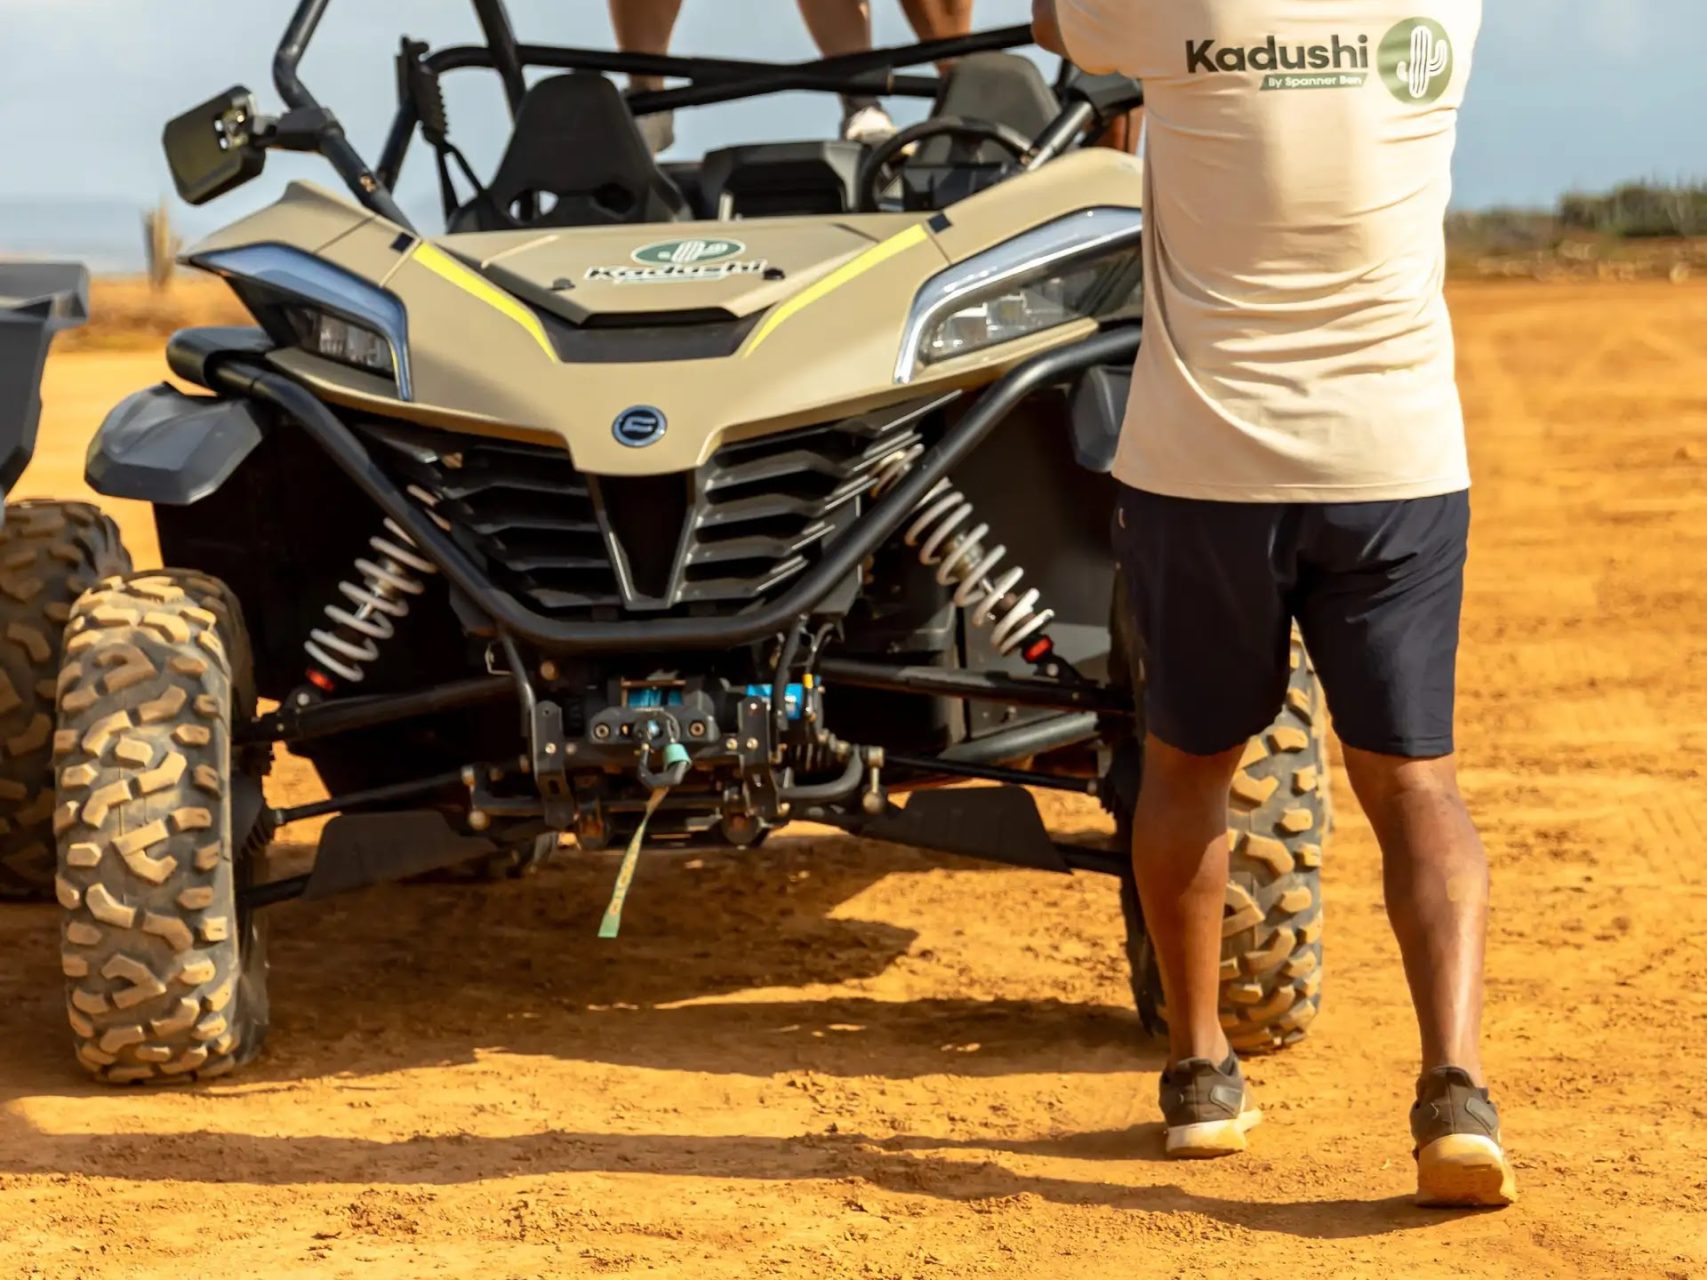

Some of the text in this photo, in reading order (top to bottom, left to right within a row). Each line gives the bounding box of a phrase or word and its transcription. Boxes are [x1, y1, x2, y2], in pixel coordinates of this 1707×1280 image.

[1185, 34, 1368, 73] Kadushi
[1267, 78, 1282, 89] By
[1285, 76, 1336, 89] Spanner
